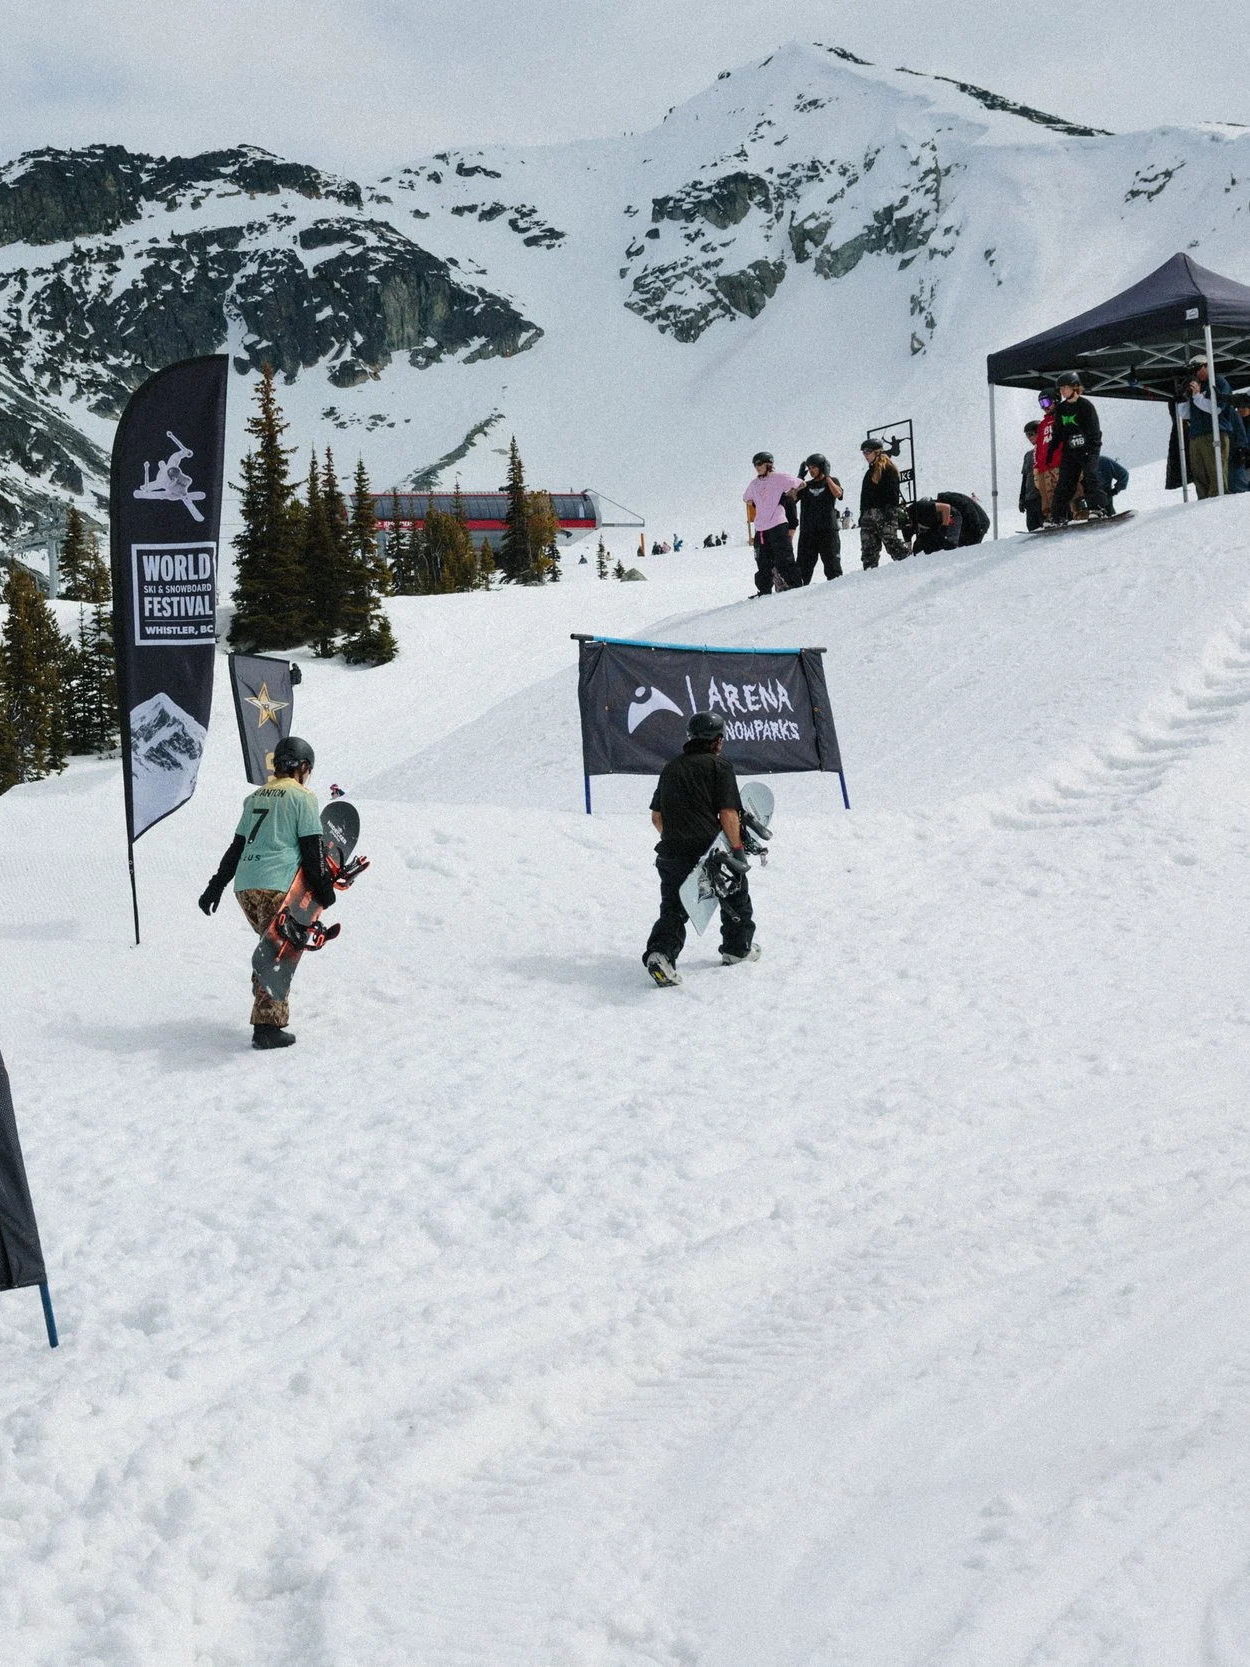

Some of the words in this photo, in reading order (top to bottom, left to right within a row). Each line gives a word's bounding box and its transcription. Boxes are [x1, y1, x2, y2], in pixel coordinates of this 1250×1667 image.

[142, 553, 211, 581] WORLD
[144, 585, 156, 594] SKI
[158, 585, 164, 594] &
[165, 583, 212, 594] SNOWBOARD
[144, 595, 213, 617] FESTIVAL
[145, 626, 198, 635] WHISTLER,
[200, 625, 214, 634] BC
[708, 676, 794, 717] ARENA
[724, 719, 800, 741] NOWPARKS
[248, 808, 269, 844] 7
